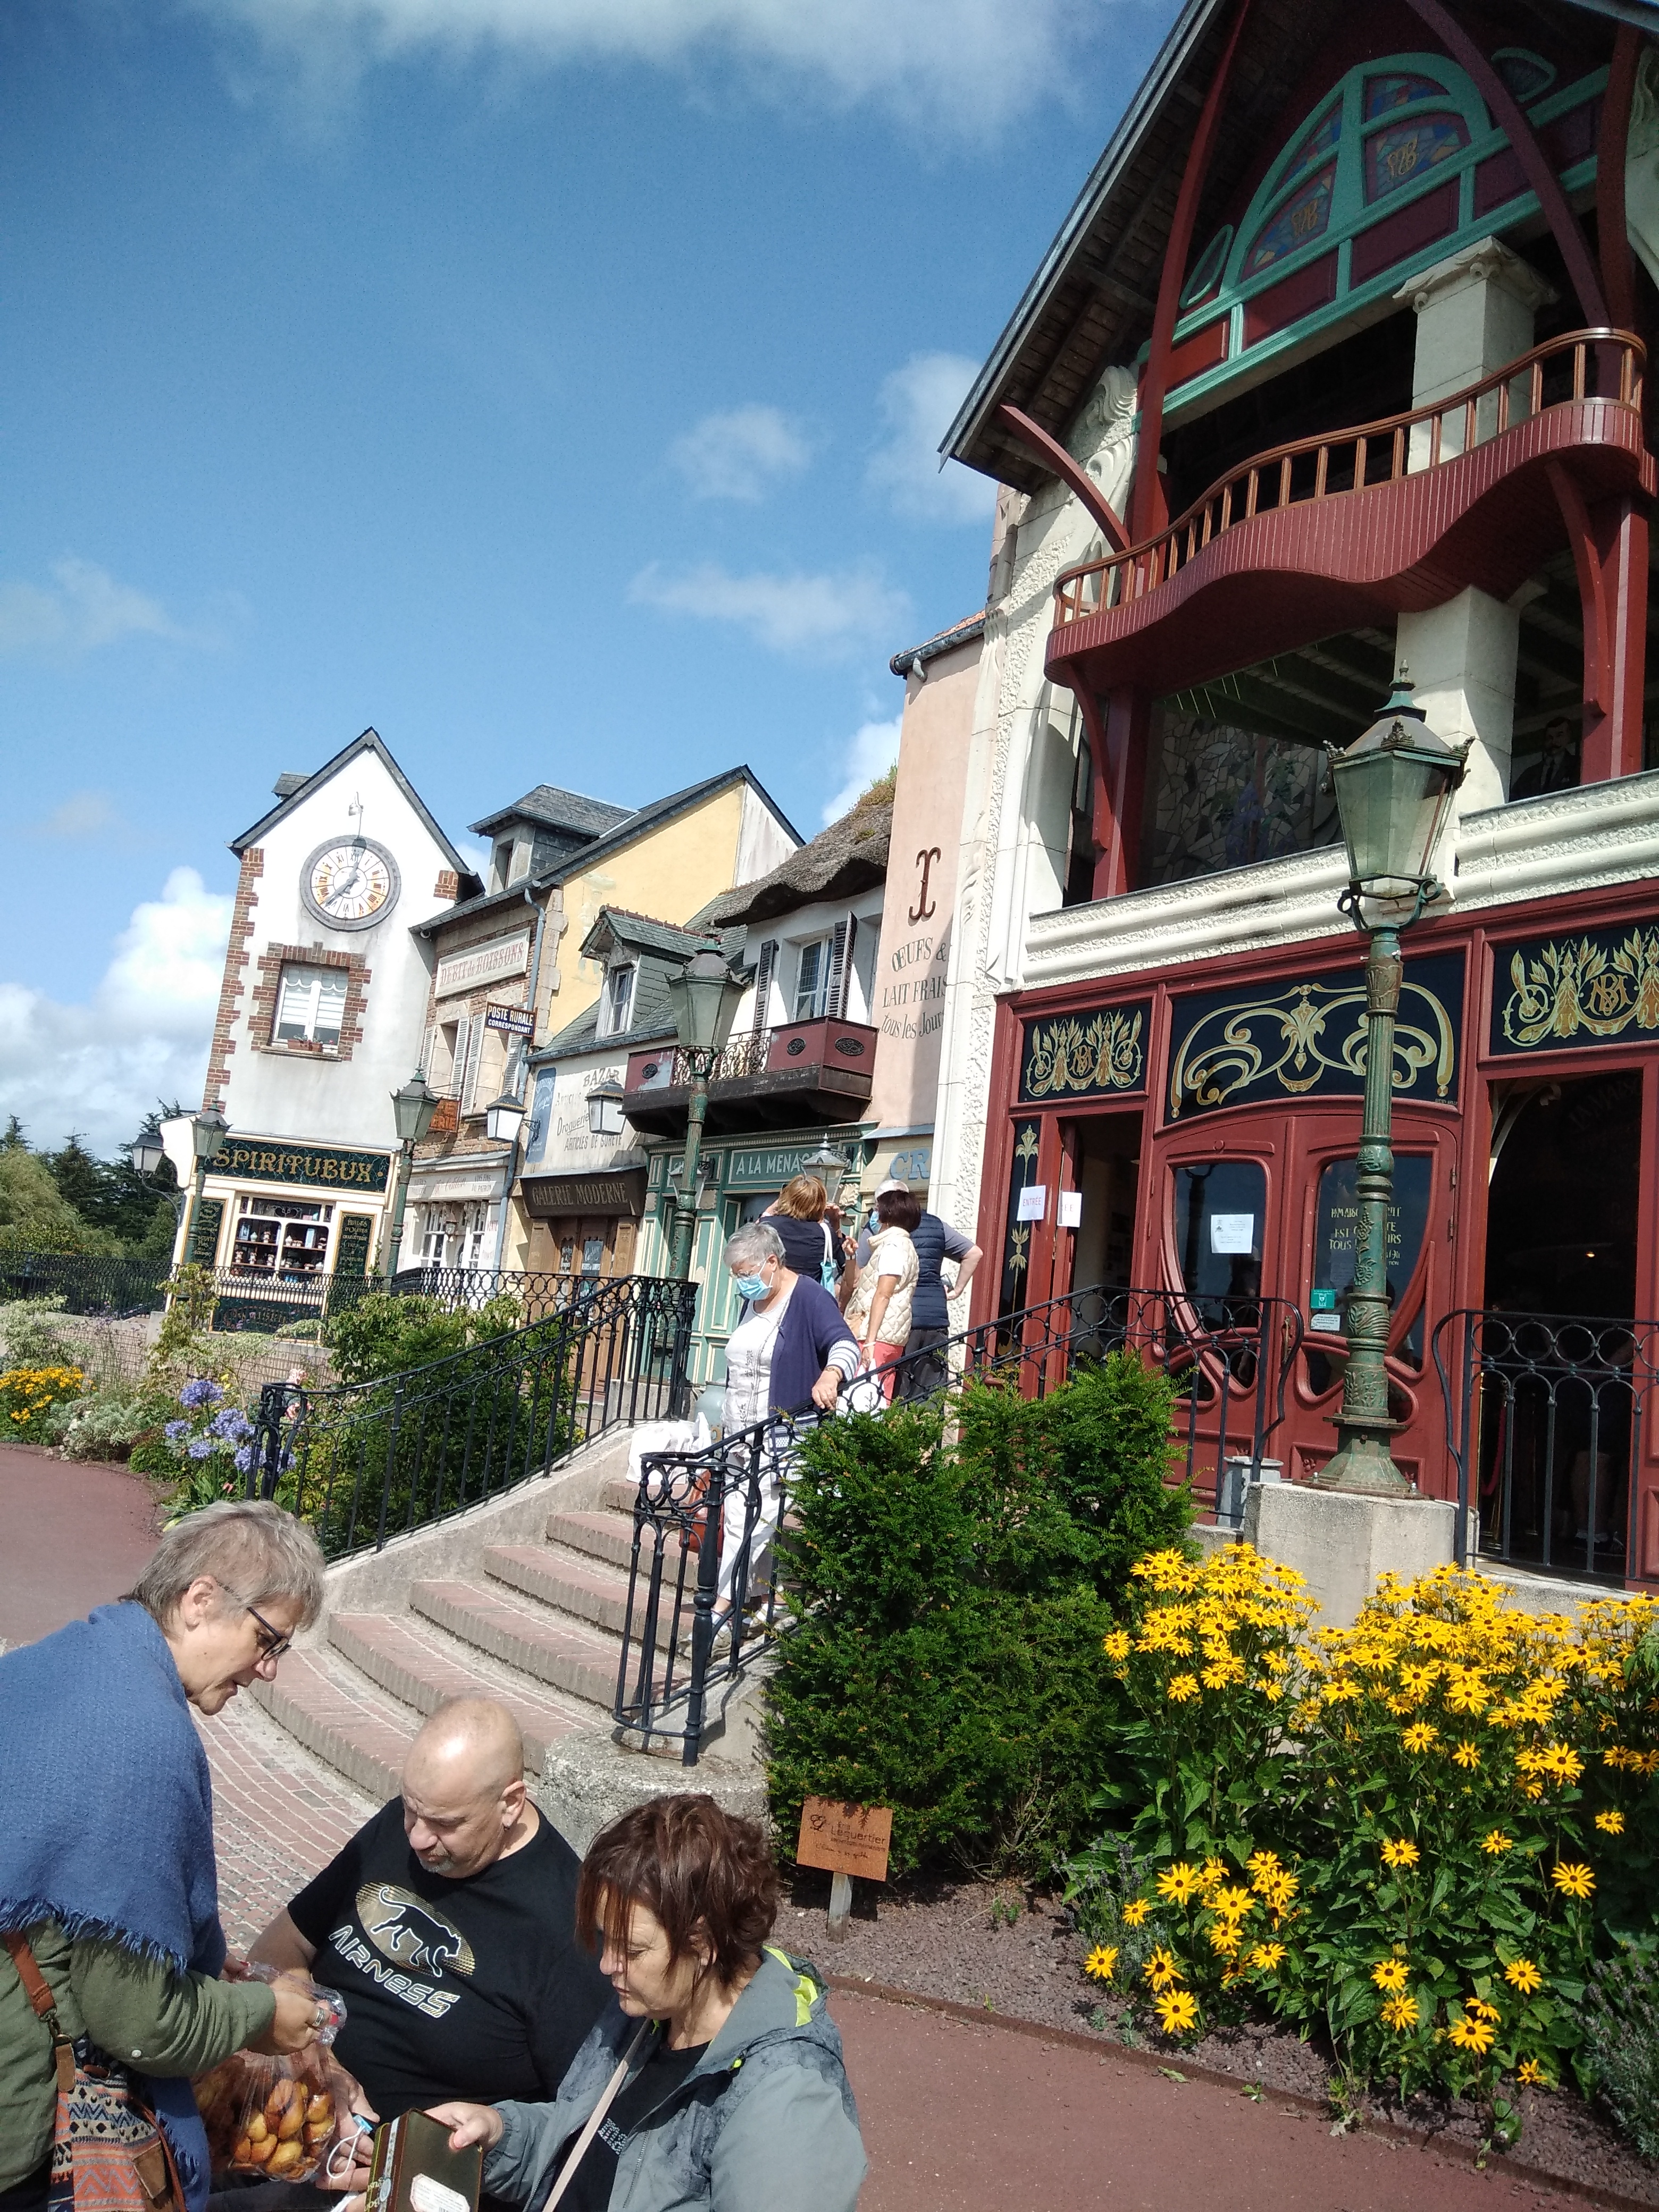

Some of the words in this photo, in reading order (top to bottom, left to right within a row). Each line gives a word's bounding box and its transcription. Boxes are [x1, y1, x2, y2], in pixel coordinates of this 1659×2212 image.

[476, 942, 524, 975] BOISSONS
[936, 942, 946, 962] &
[882, 983, 910, 1008] LAIT
[487, 1005, 508, 1020] POSTE
[509, 1009, 534, 1026] RURALE
[881, 1012, 901, 1037] tous
[902, 1013, 917, 1039] les
[488, 1019, 531, 1034] CORRESPONDANT
[583, 1067, 621, 1087] BAZAR
[564, 1134, 588, 1152] ARTICLES
[591, 1134, 598, 1149] DE
[213, 1147, 373, 1183] SPIRITUEUX
[748, 1154, 761, 1175] LA
[477, 1184, 492, 1192] PATRON
[532, 1184, 574, 1206] GALERIE
[575, 1182, 629, 1205] MODERNE
[1023, 1197, 1042, 1206] ENTRÉE
[1328, 1238, 1352, 1250] TOUS
